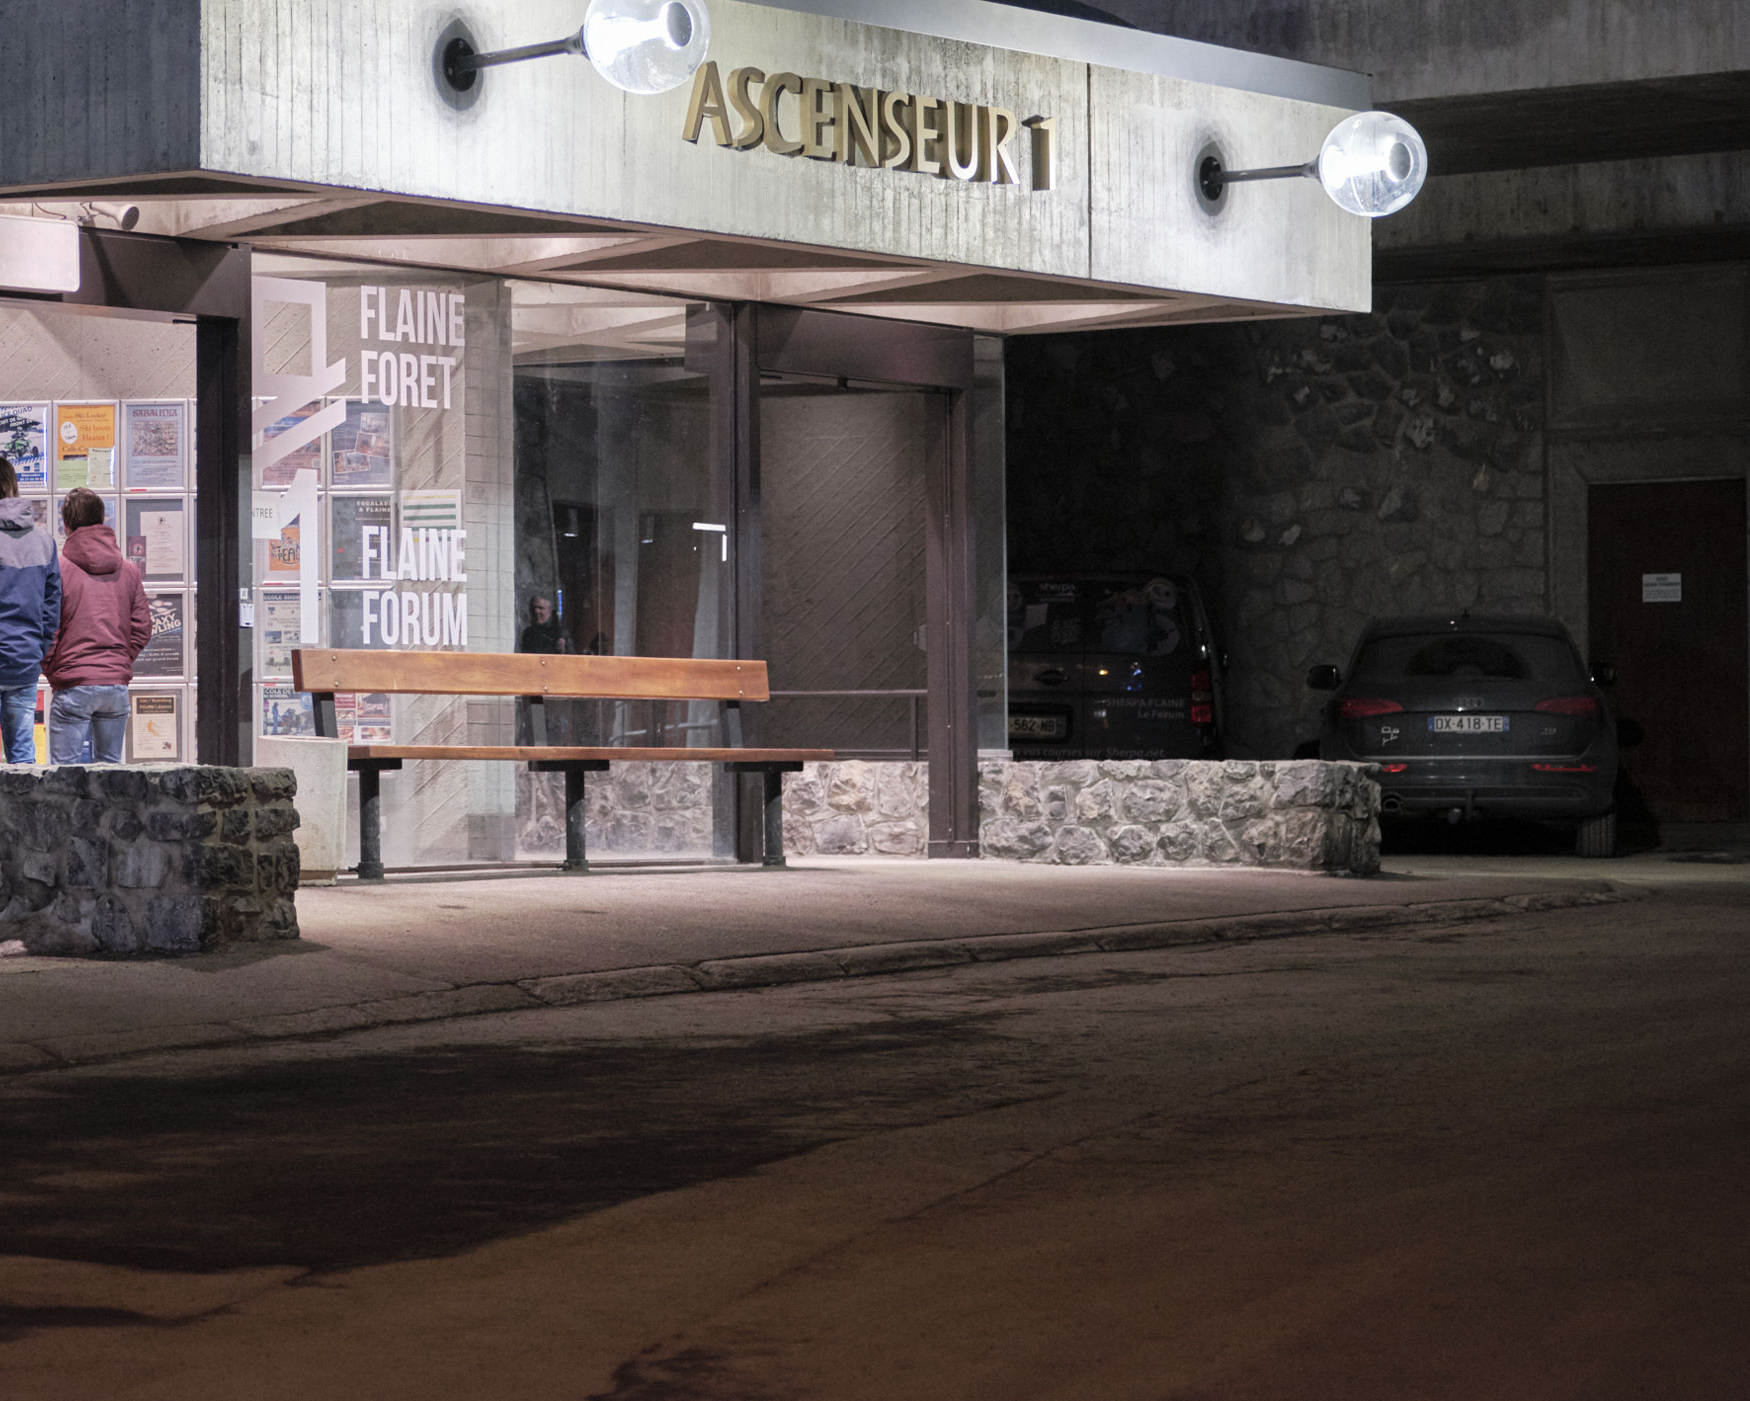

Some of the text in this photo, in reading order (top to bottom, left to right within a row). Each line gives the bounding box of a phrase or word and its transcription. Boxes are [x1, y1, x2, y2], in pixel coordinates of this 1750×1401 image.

[682, 60, 1057, 192] ASCENSEUR 1
[360, 285, 466, 347] FLAINE
[361, 350, 456, 410] FORET
[13, 406, 33, 417] QUAD
[132, 408, 178, 418] SABAUDIA
[252, 507, 273, 519] NTREE
[362, 525, 467, 582] FLAINE
[1040, 583, 1075, 592] sherpa
[362, 590, 468, 647] FORUM
[1105, 699, 1185, 707] SHERPA FLAINE
[1138, 710, 1185, 719] Le Forum
[1435, 717, 1502, 731] DX-418-TE
